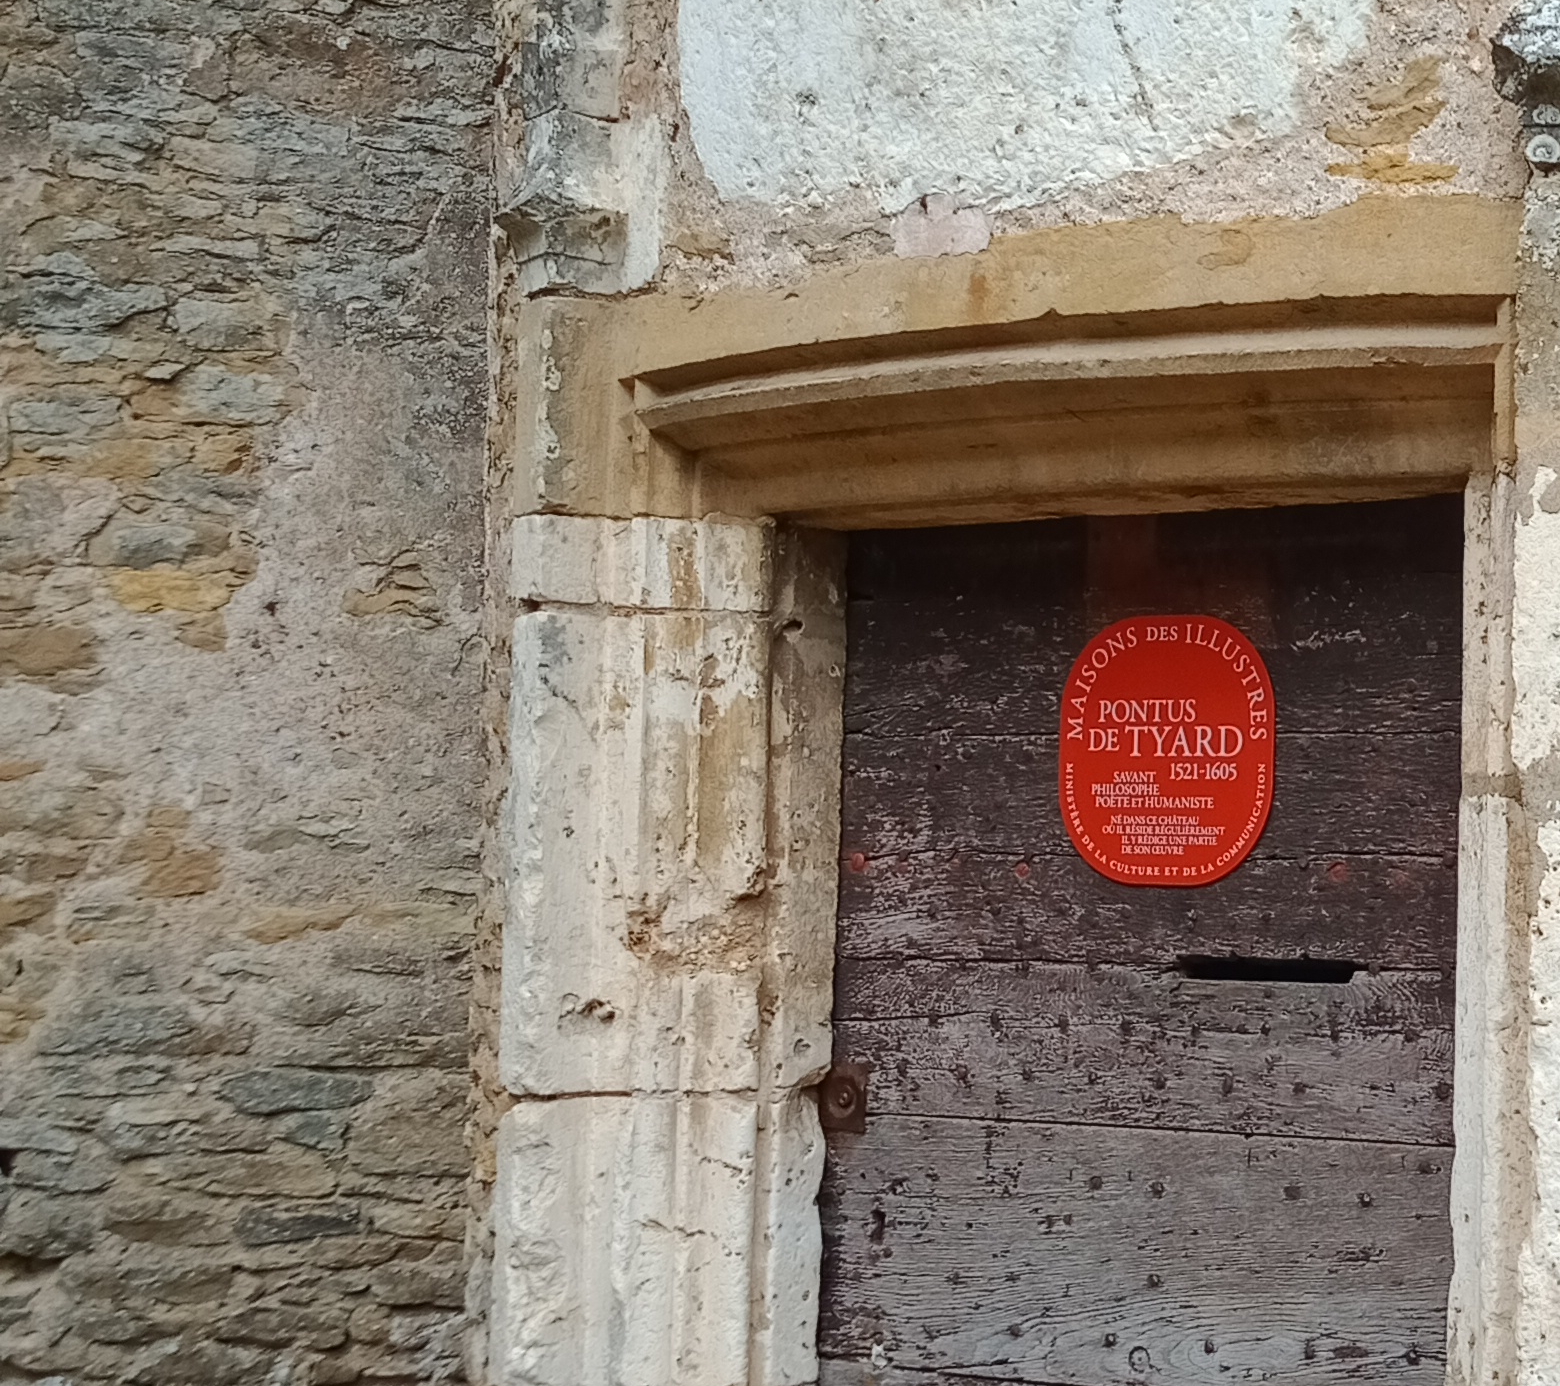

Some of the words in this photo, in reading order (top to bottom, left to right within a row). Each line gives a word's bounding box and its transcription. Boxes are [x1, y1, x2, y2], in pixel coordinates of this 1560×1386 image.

[1067, 626, 1137, 740] MAISONS
[1146, 626, 1178, 641] DES
[1185, 623, 1267, 740] ILLUSTRES
[1098, 699, 1196, 722] PONTUS
[1088, 728, 1120, 751] DE
[1125, 725, 1243, 757] TYARD
[1113, 771, 1156, 783] SAVANT
[1169, 762, 1237, 781] 1521-1605
[1091, 783, 1160, 795] PHILOSOPHE
[1131, 798, 1144, 808] ET
[1145, 796, 1214, 809] HUMANISTE
[1065, 762, 1085, 835] MINISTÈRE
[1081, 834, 1095, 851] DE
[1094, 849, 1107, 864] LA
[1109, 860, 1160, 876] CULTURE
[1164, 866, 1179, 876] ET
[1183, 866, 1198, 876] DE
[1200, 863, 1215, 874] LA
[1216, 763, 1266, 866] COMMUNICATION
[1110, 813, 1122, 824] NÉ
[1123, 815, 1145, 825] DANS
[1146, 816, 1158, 825] CE
[1158, 814, 1199, 825] CHÂTEAU
[1116, 825, 1124, 834] IL
[1125, 824, 1153, 834] RÉSIDE
[1121, 835, 1130, 844] IL
[1130, 835, 1138, 844] Y
[1138, 834, 1168, 845] RÉDIGE
[1169, 836, 1187, 845] UNE
[1188, 836, 1218, 846] PARTIE
[1121, 845, 1133, 854] DE
[1133, 845, 1150, 855] SON
